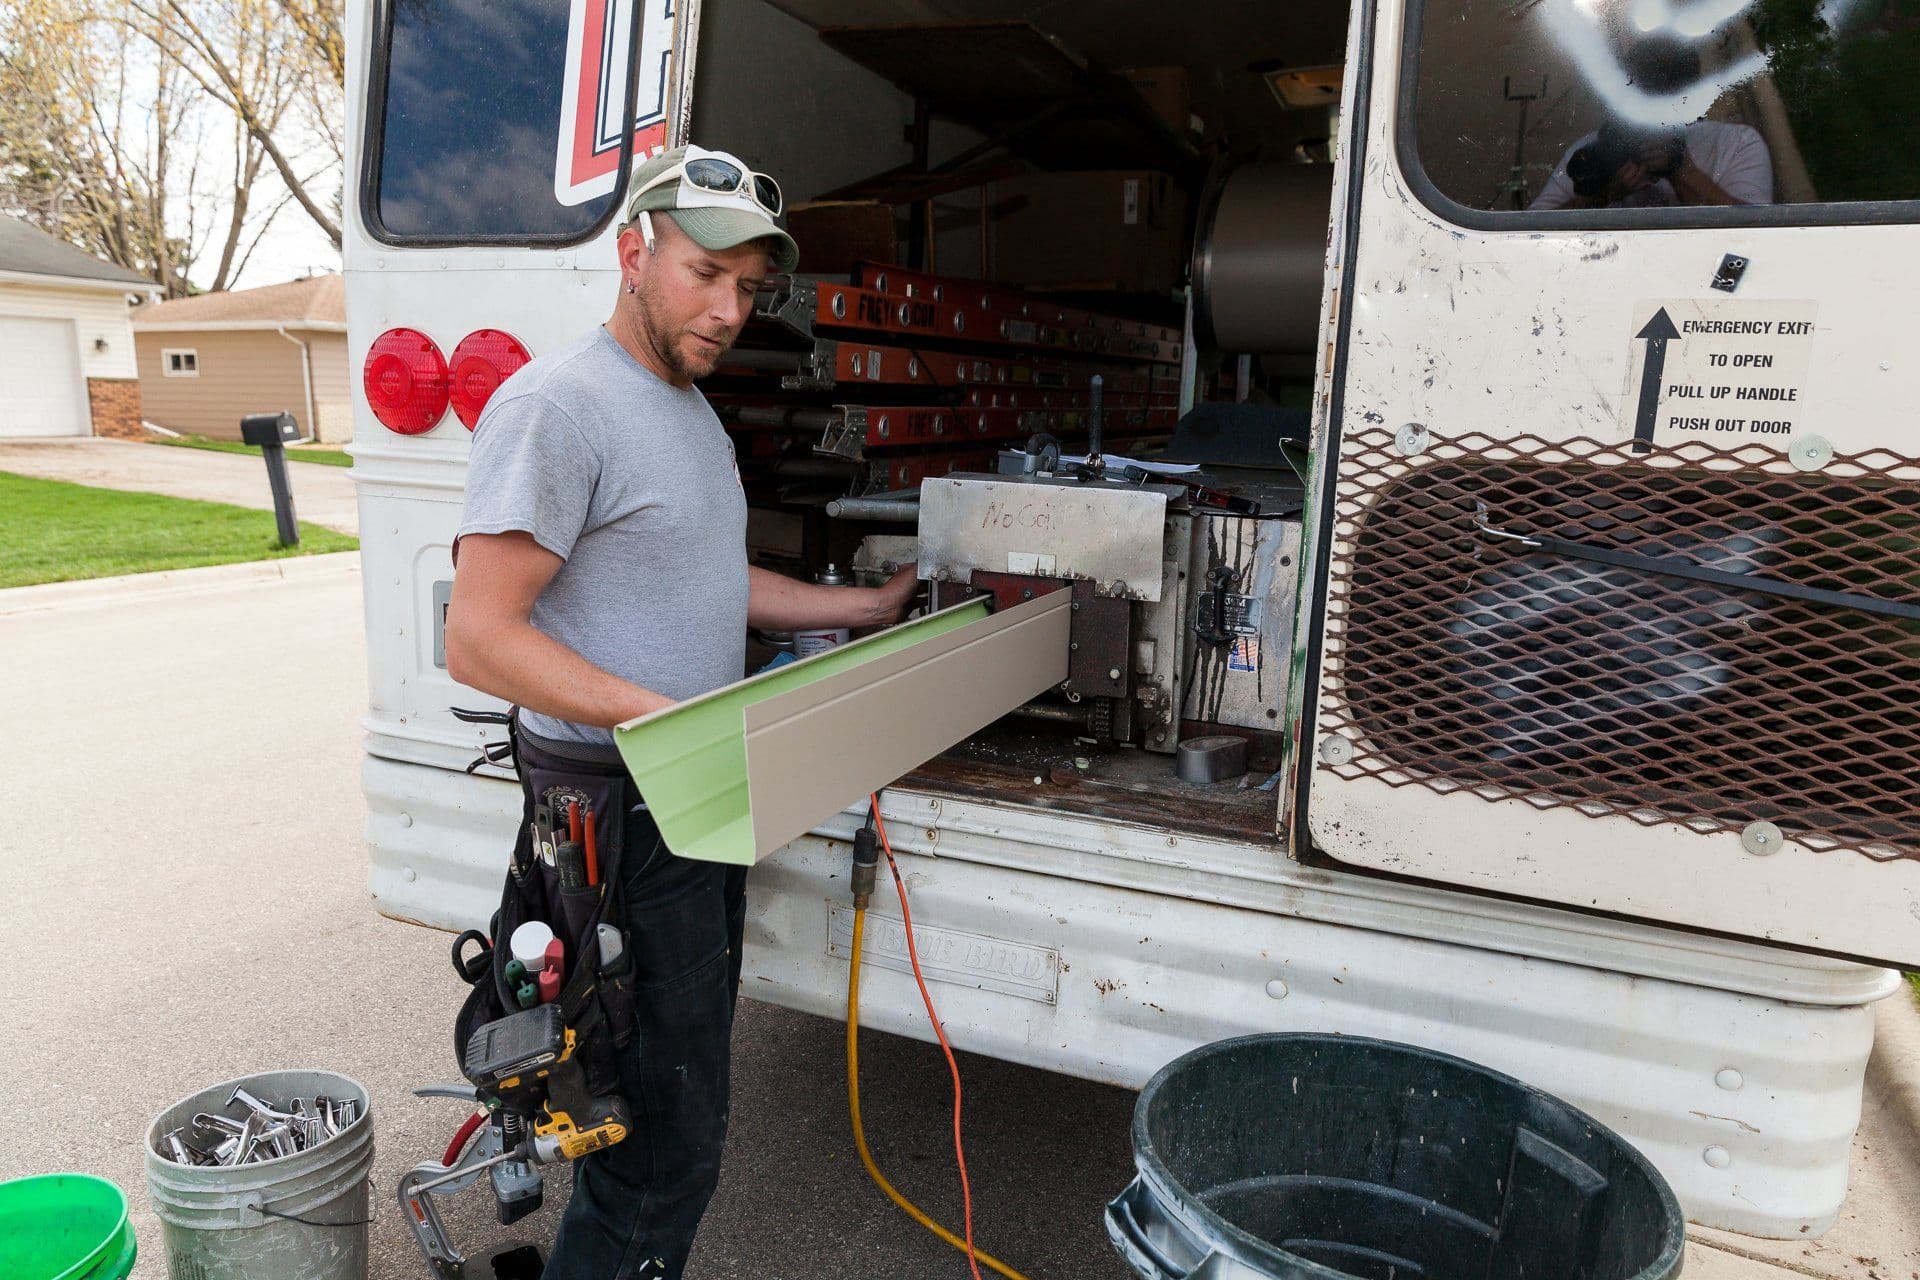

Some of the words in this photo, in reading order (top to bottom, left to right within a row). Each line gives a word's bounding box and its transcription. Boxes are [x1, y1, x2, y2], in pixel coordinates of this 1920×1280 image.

[1682, 320, 1773, 334] EMERGENCY
[1777, 321, 1812, 335] EXIT
[1709, 353, 1728, 367] TO
[1733, 354, 1773, 367] OPEN
[1668, 385, 1704, 398] PULL
[1710, 386, 1731, 399] UP
[1736, 387, 1797, 401] HANDLE
[1669, 416, 1710, 431] PUSH
[1715, 418, 1746, 432] OUT
[1750, 420, 1792, 434] DOOR
[962, 940, 1044, 981] BIRD
